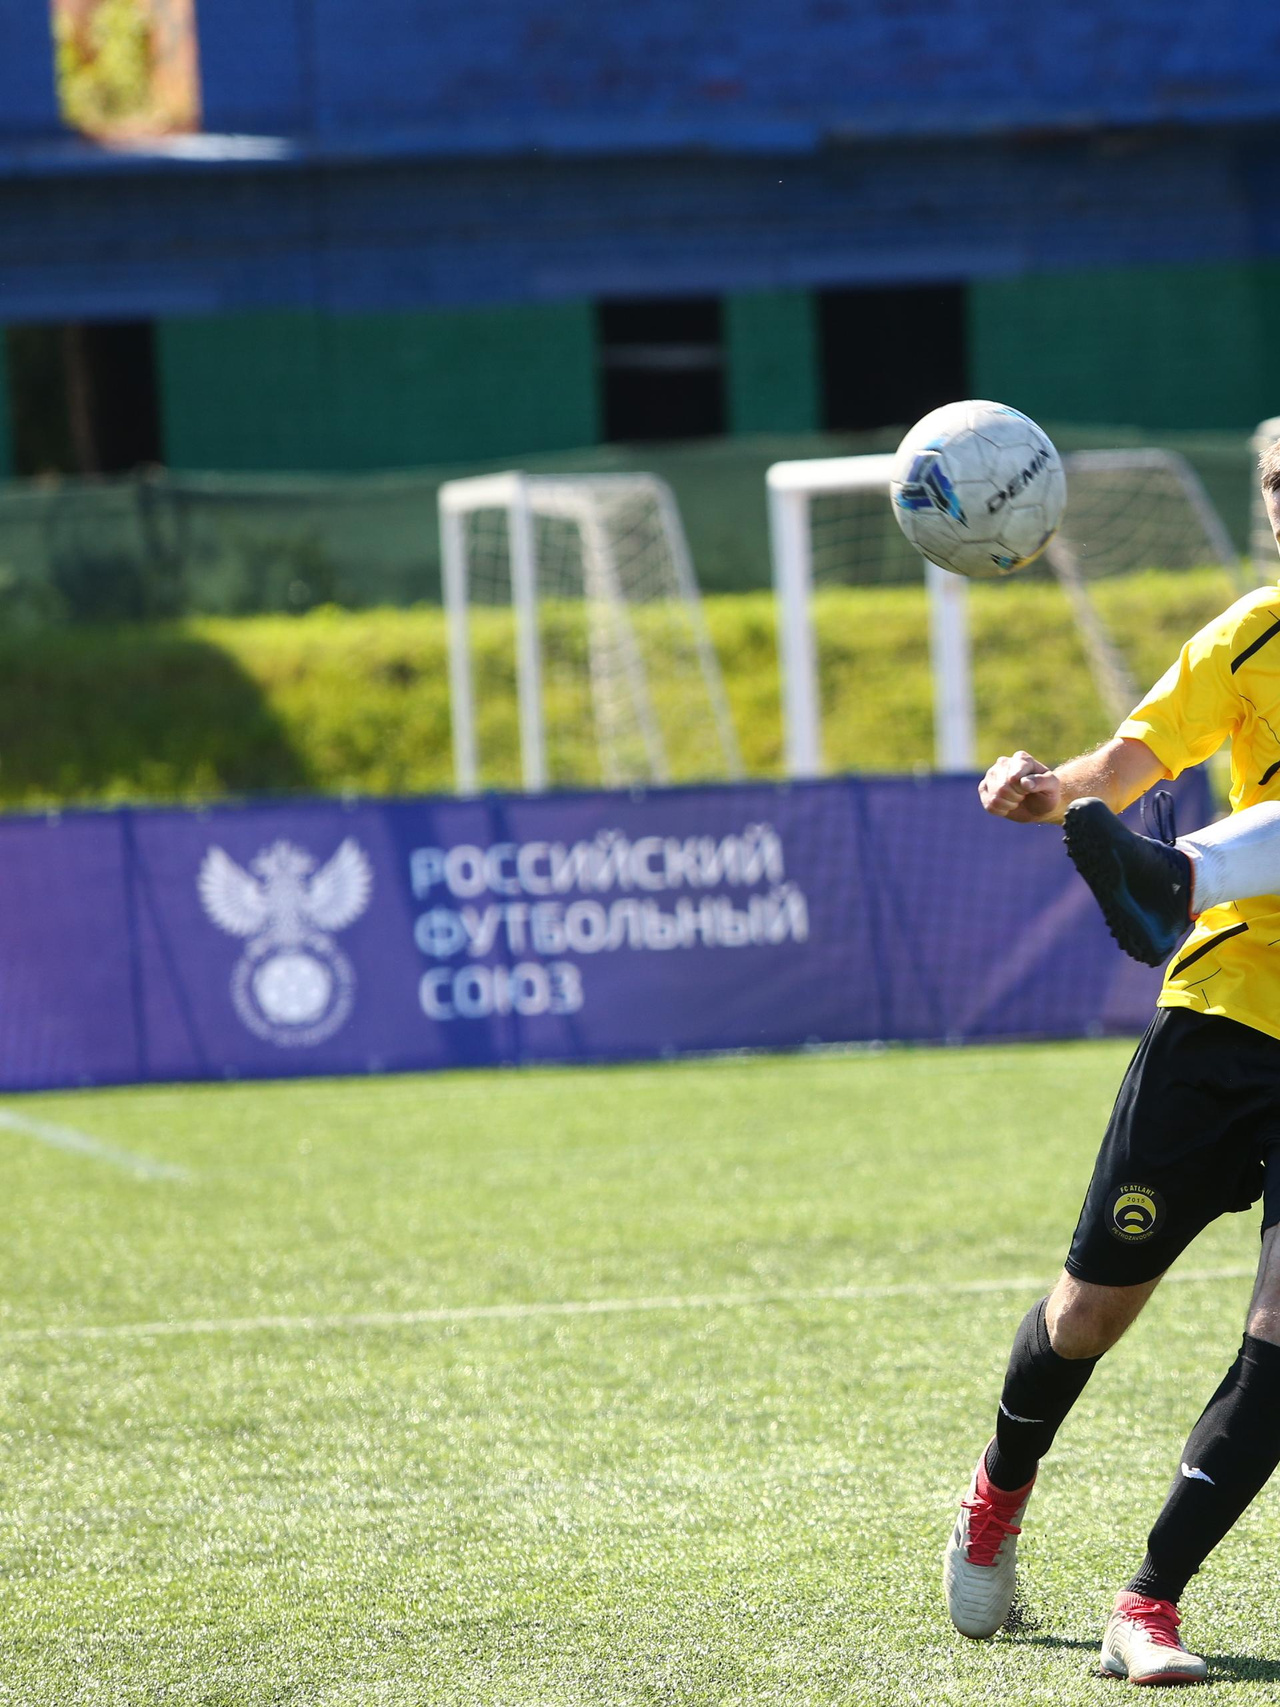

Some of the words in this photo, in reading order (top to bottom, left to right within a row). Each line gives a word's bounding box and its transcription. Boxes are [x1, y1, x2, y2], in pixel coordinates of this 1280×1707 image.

[410, 824, 784, 899] РОССИЙСКИЙ
[414, 882, 809, 958] ФУТБОЛЬНЫЙ
[420, 961, 584, 1021] СОЮЗ
[1120, 1185, 1129, 1194] FC
[1129, 1184, 1155, 1197] ATLANT
[1126, 1196, 1146, 1204] 2015
